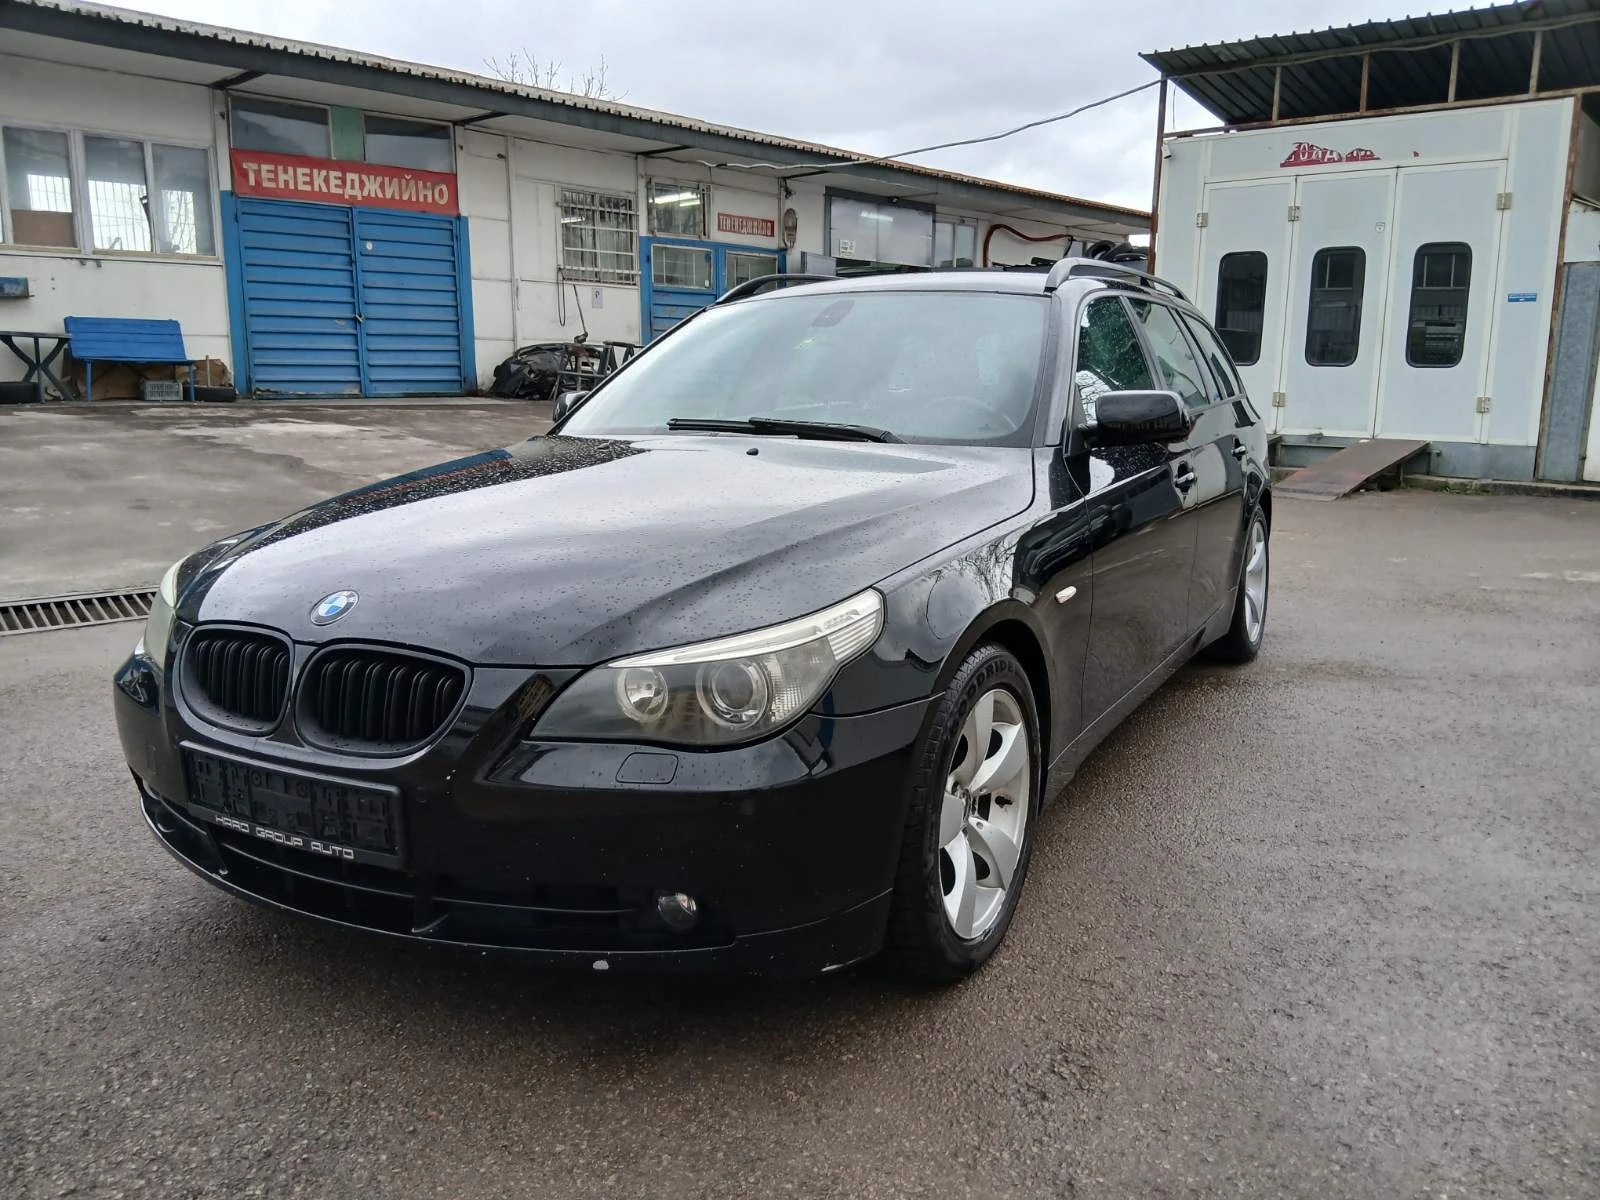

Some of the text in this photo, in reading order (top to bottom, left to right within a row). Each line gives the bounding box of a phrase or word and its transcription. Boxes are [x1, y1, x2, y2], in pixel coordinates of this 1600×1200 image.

[242, 162, 449, 205] ТЕНЕКЕДЖИЙНО
[255, 827, 303, 847] GROUP
[310, 841, 354, 859] AUTO
